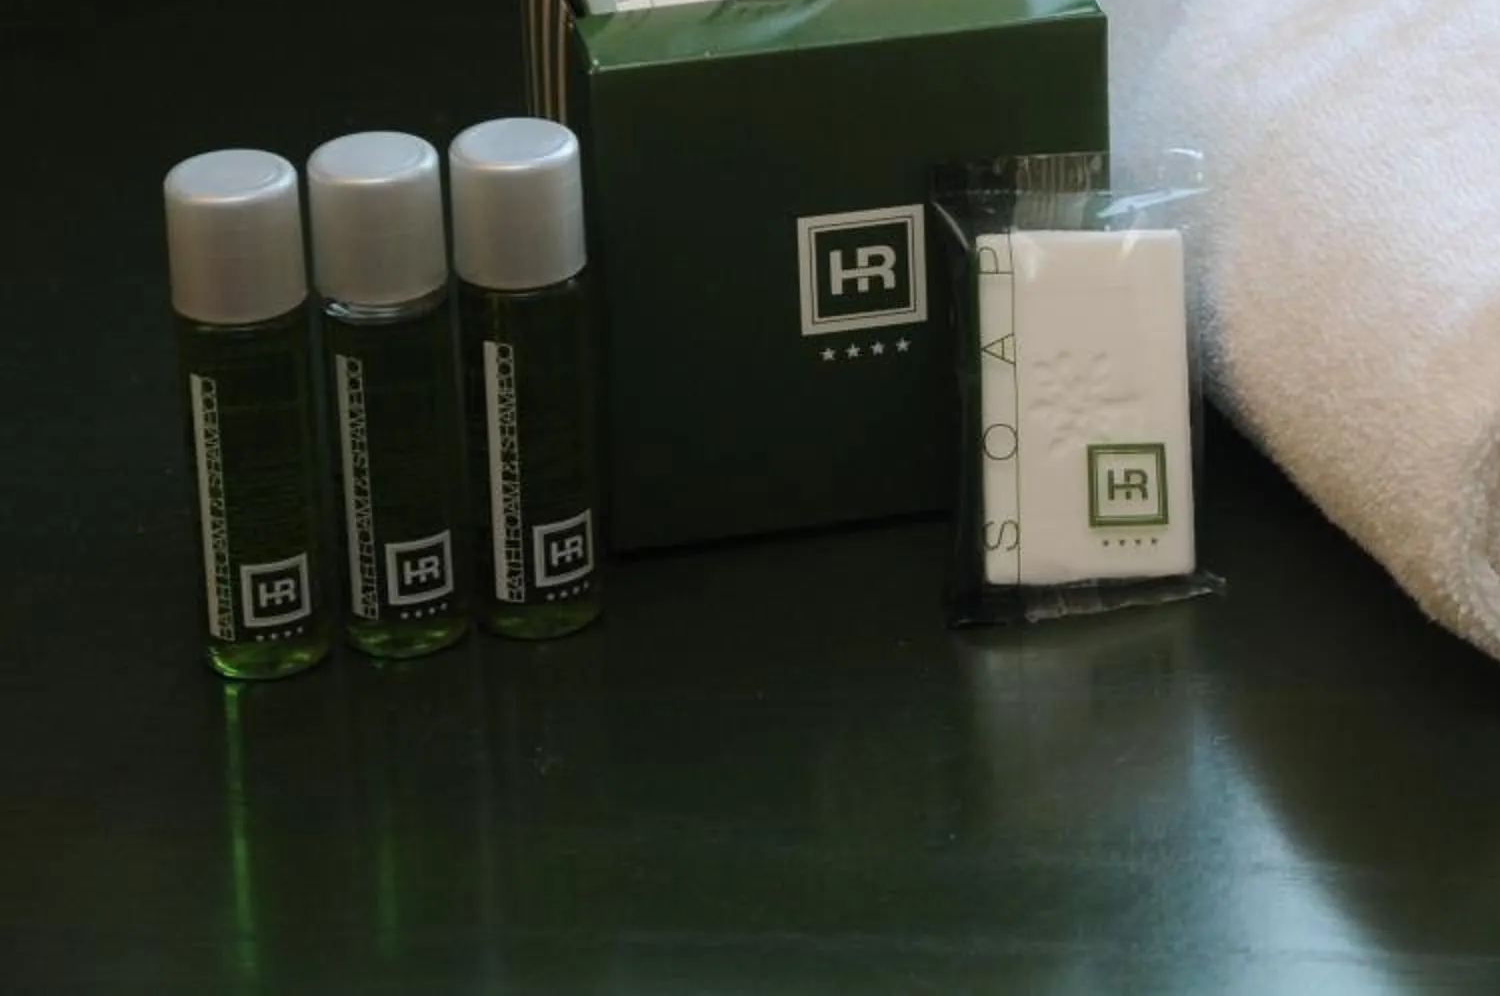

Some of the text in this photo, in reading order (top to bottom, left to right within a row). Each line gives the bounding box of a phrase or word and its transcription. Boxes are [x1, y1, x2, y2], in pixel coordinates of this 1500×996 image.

[829, 244, 896, 295] HR
[979, 245, 1020, 551] SOAP
[1107, 468, 1149, 501] HR
[551, 535, 584, 567] HR
[403, 555, 440, 585] HR
[258, 578, 296, 608] HR
